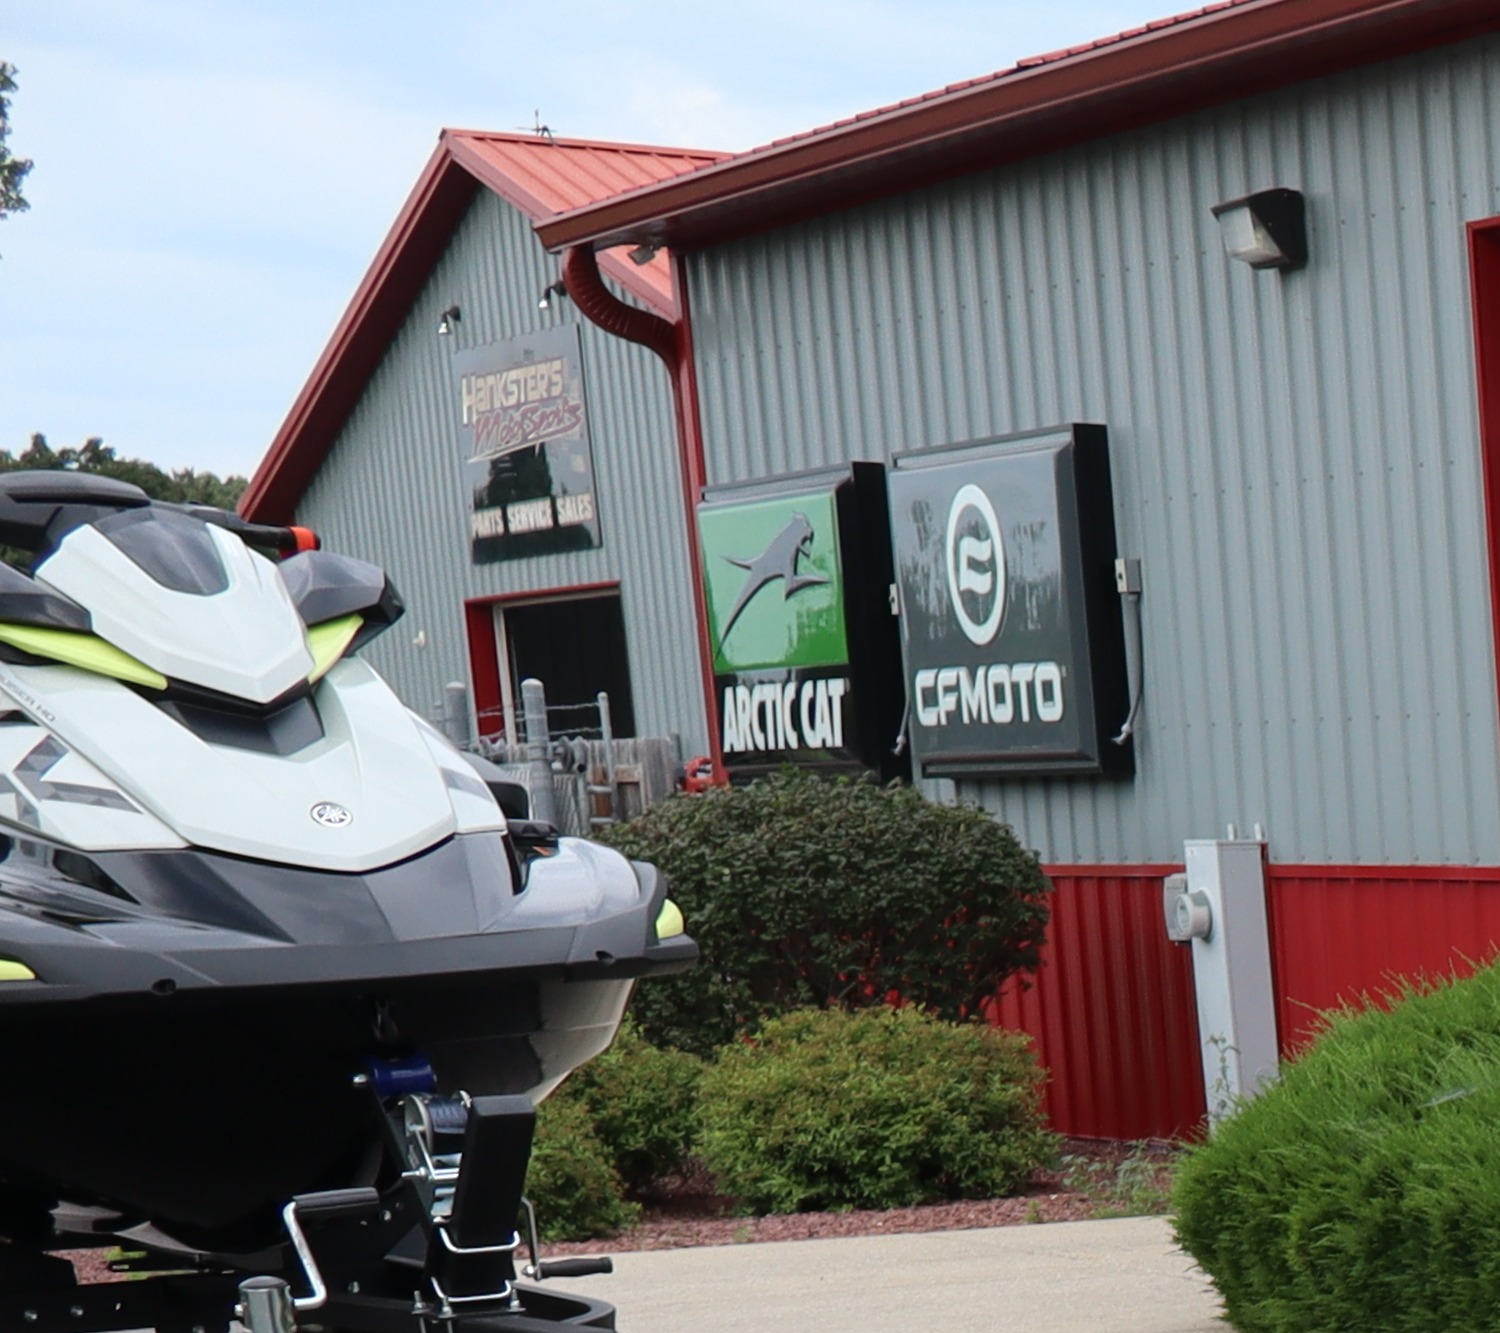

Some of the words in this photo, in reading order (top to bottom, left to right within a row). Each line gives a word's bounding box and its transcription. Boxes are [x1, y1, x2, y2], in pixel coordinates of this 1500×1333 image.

[473, 509, 503, 537] PARTS
[507, 498, 553, 533] SERVICE
[558, 496, 592, 525] SALES
[723, 681, 798, 753] ARCTIC
[800, 677, 845, 749] CAT
[914, 660, 1065, 727] CFMOTO
